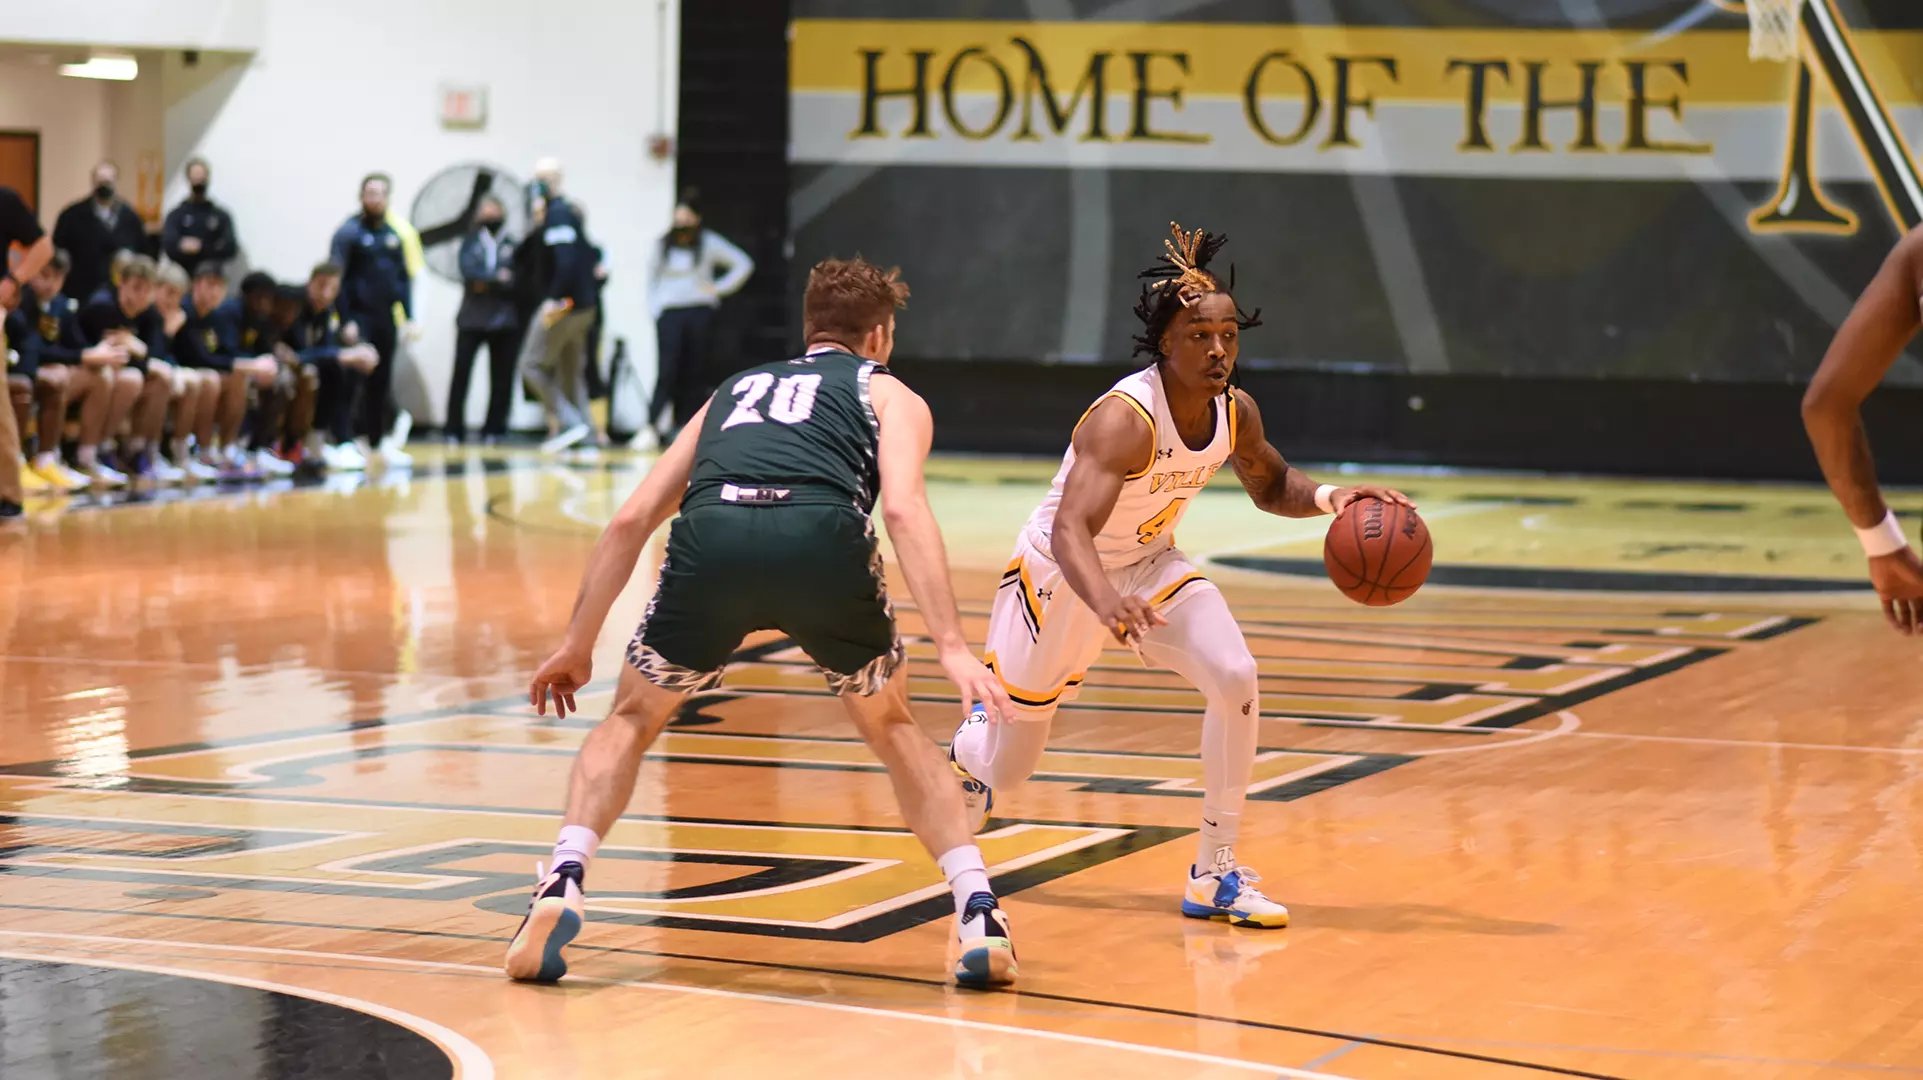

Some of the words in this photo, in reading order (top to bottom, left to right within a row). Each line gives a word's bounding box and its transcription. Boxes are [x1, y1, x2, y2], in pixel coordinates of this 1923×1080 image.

[848, 36, 1212, 143] HOME
[1242, 49, 1400, 149] OF
[1444, 57, 1713, 155] THE
[720, 372, 823, 432] 20
[1136, 497, 1188, 545] 4
[1363, 498, 1384, 541] Wils
